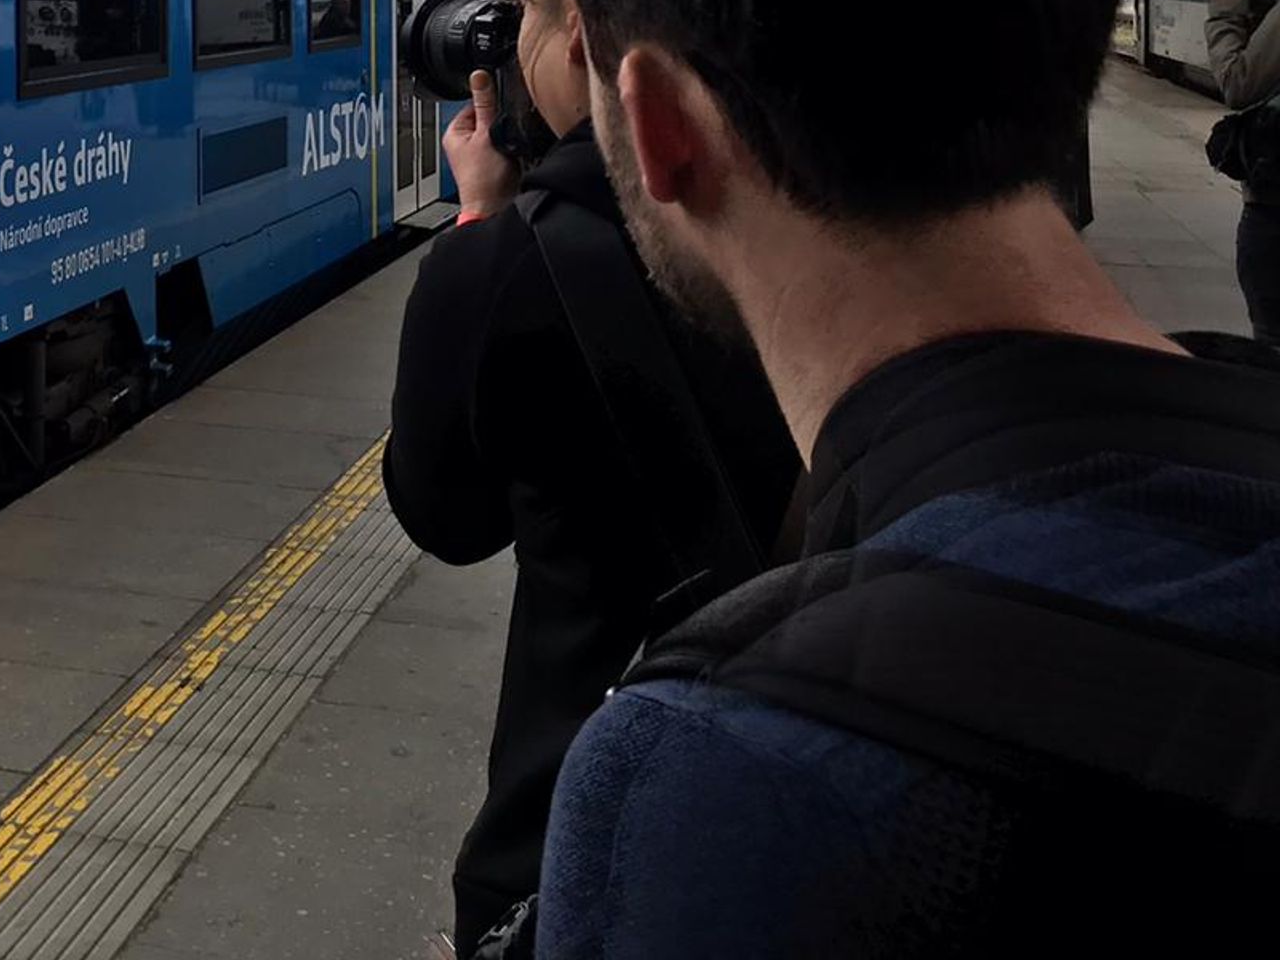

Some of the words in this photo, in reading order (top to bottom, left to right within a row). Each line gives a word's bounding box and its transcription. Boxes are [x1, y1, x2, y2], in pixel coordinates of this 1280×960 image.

[0, 141, 67, 207] České
[73, 131, 132, 184] dráhy
[302, 92, 385, 176] ALSTOM
[0, 213, 43, 252] Národní
[44, 206, 90, 238] dopravce
